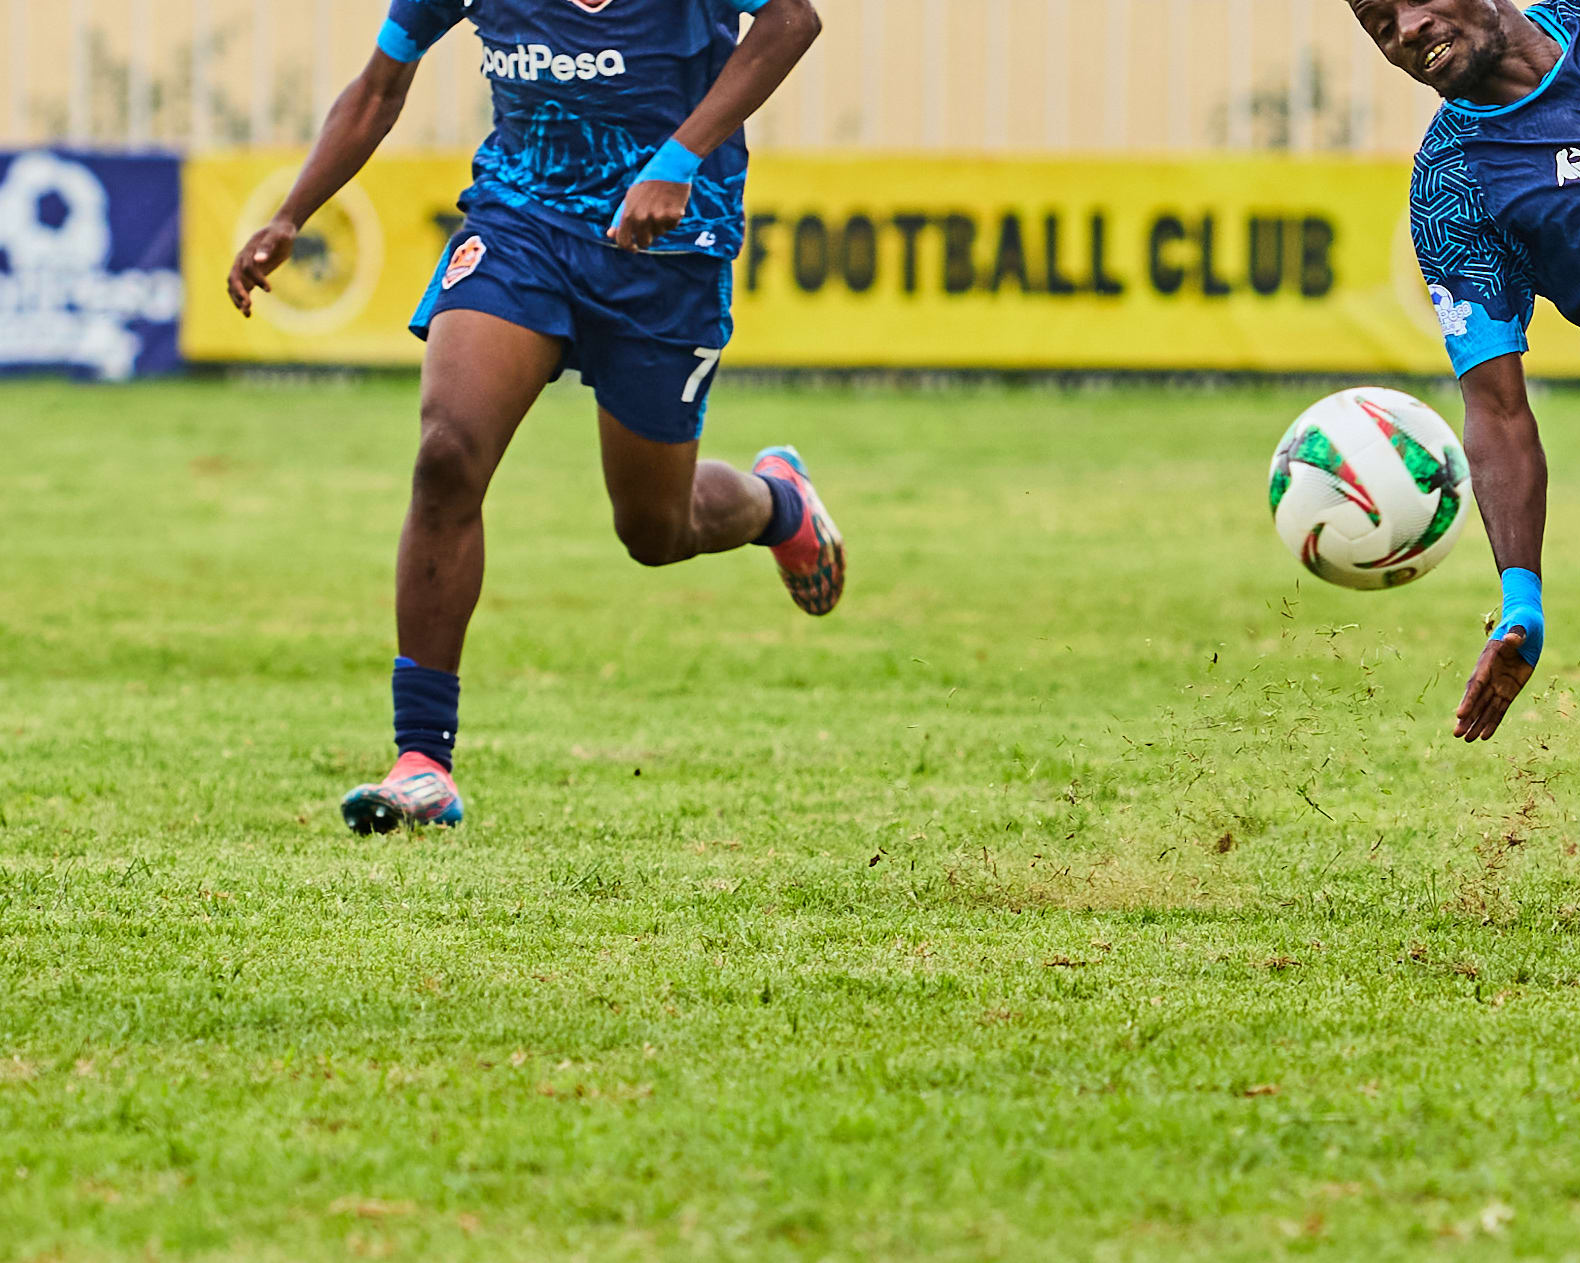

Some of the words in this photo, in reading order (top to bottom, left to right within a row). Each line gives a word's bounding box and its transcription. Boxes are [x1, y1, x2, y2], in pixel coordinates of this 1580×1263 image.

[480, 43, 626, 81] portPesa
[743, 210, 1124, 295] FOOTBALL
[1147, 210, 1337, 297] CLUB
[681, 346, 721, 403] 7
